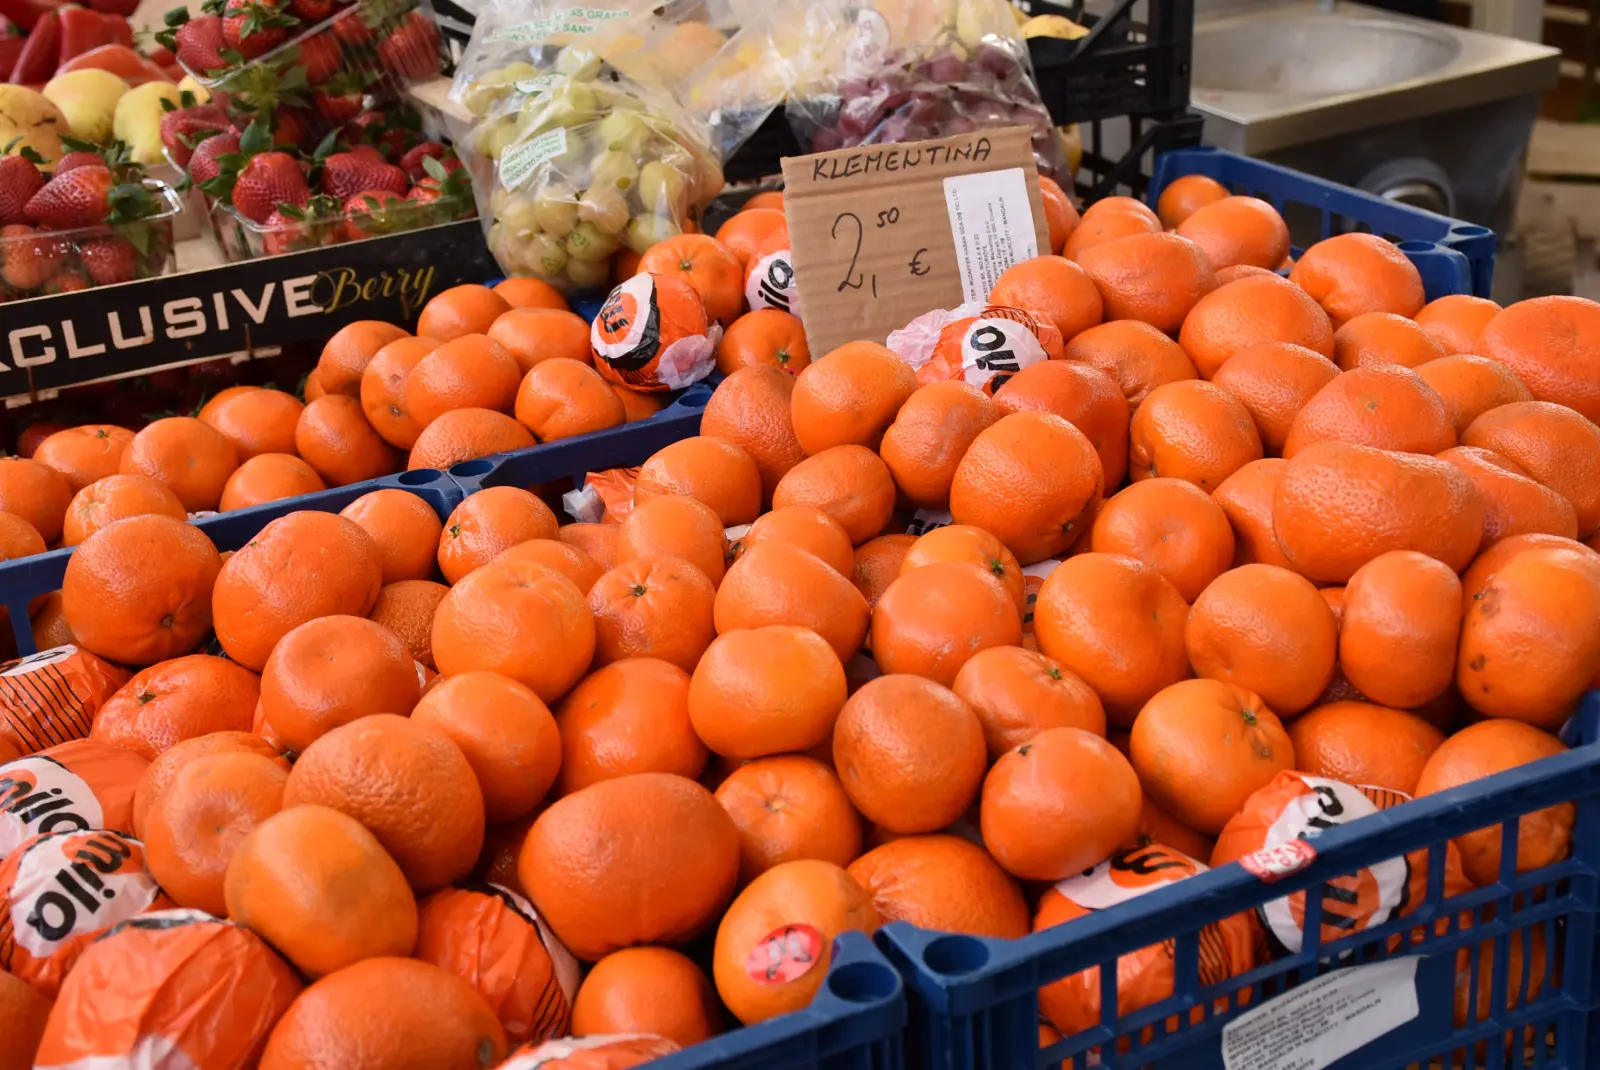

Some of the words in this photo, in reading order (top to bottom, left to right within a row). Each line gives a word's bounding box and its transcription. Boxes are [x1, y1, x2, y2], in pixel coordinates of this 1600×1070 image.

[812, 137, 992, 182] KLEMENTINA
[757, 258, 794, 312] ila
[907, 247, 932, 277] €
[311, 265, 436, 314] Berry
[0, 275, 324, 373] CLUSIVE
[970, 325, 1020, 395] ila
[26, 833, 131, 942] mila
